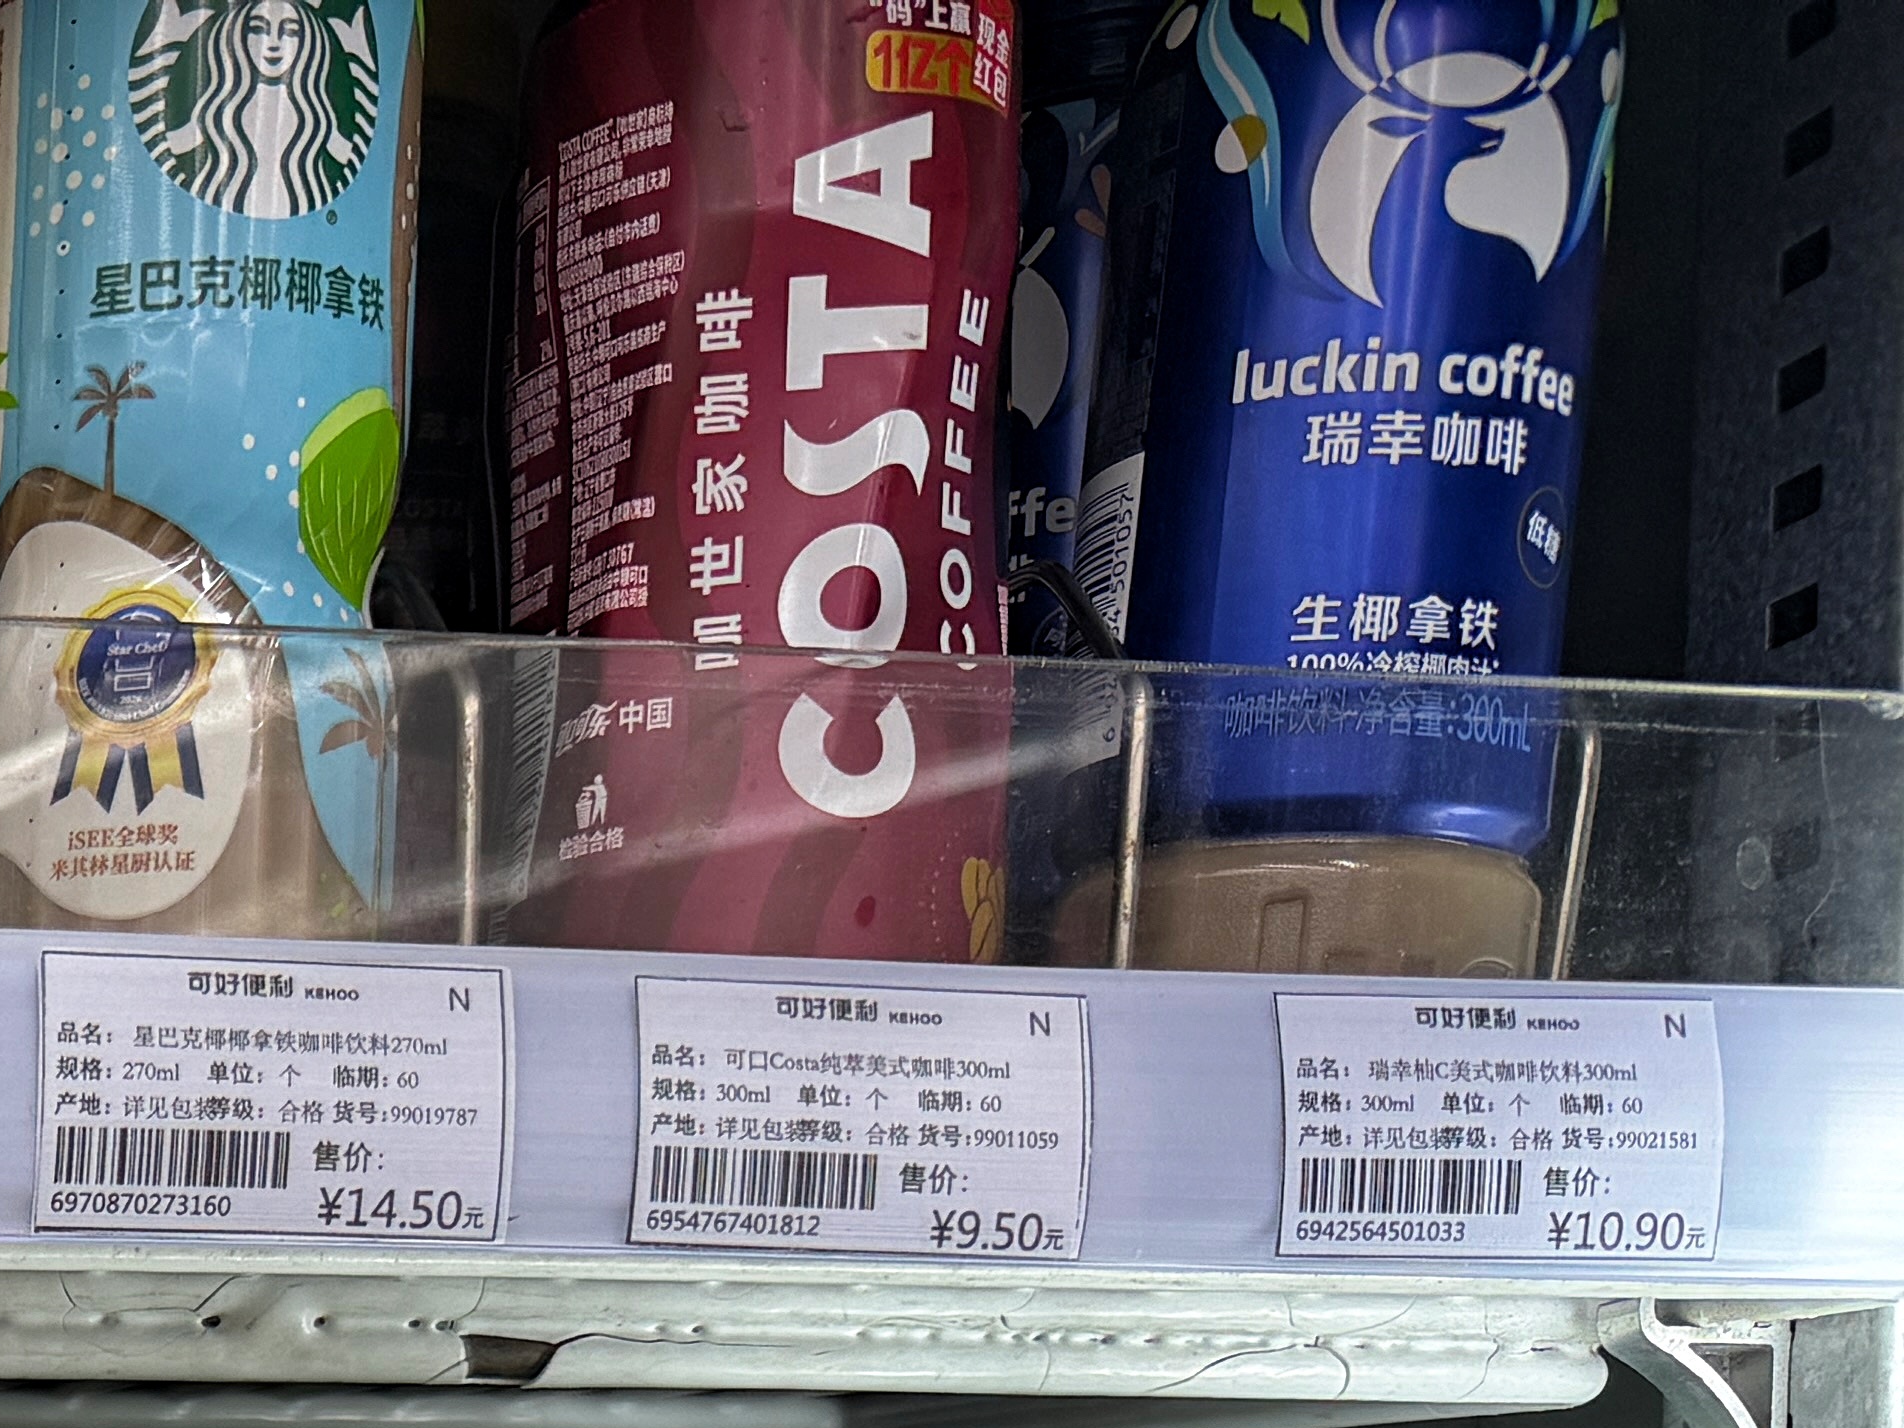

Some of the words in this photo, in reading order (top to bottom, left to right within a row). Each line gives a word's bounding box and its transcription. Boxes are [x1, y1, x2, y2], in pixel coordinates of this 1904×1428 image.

[88, 251, 388, 333] 星巴克椰椰拿铁
[1232, 335, 1420, 404] luckin
[1438, 343, 1575, 417] coffee
[777, 110, 936, 819] COSTA
[1302, 409, 1530, 477] 瑞幸咖啡
[690, 287, 754, 672] 咖世家咖啡
[939, 288, 993, 672] COFFEE
[1290, 592, 1499, 650] 生椰拿铁
[68, 823, 179, 851] iSEE全球奖
[1415, 1006, 1517, 1030] 可好便利
[50, 1189, 232, 1217] 6970870273160
[316, 1185, 484, 1231] ¥14.50元
[645, 1209, 821, 1237] 6954767401812
[931, 1208, 1064, 1252] ¥9.50元
[1295, 1219, 1466, 1243] 6942564501033
[1547, 1210, 1706, 1253] ¥10.90元
